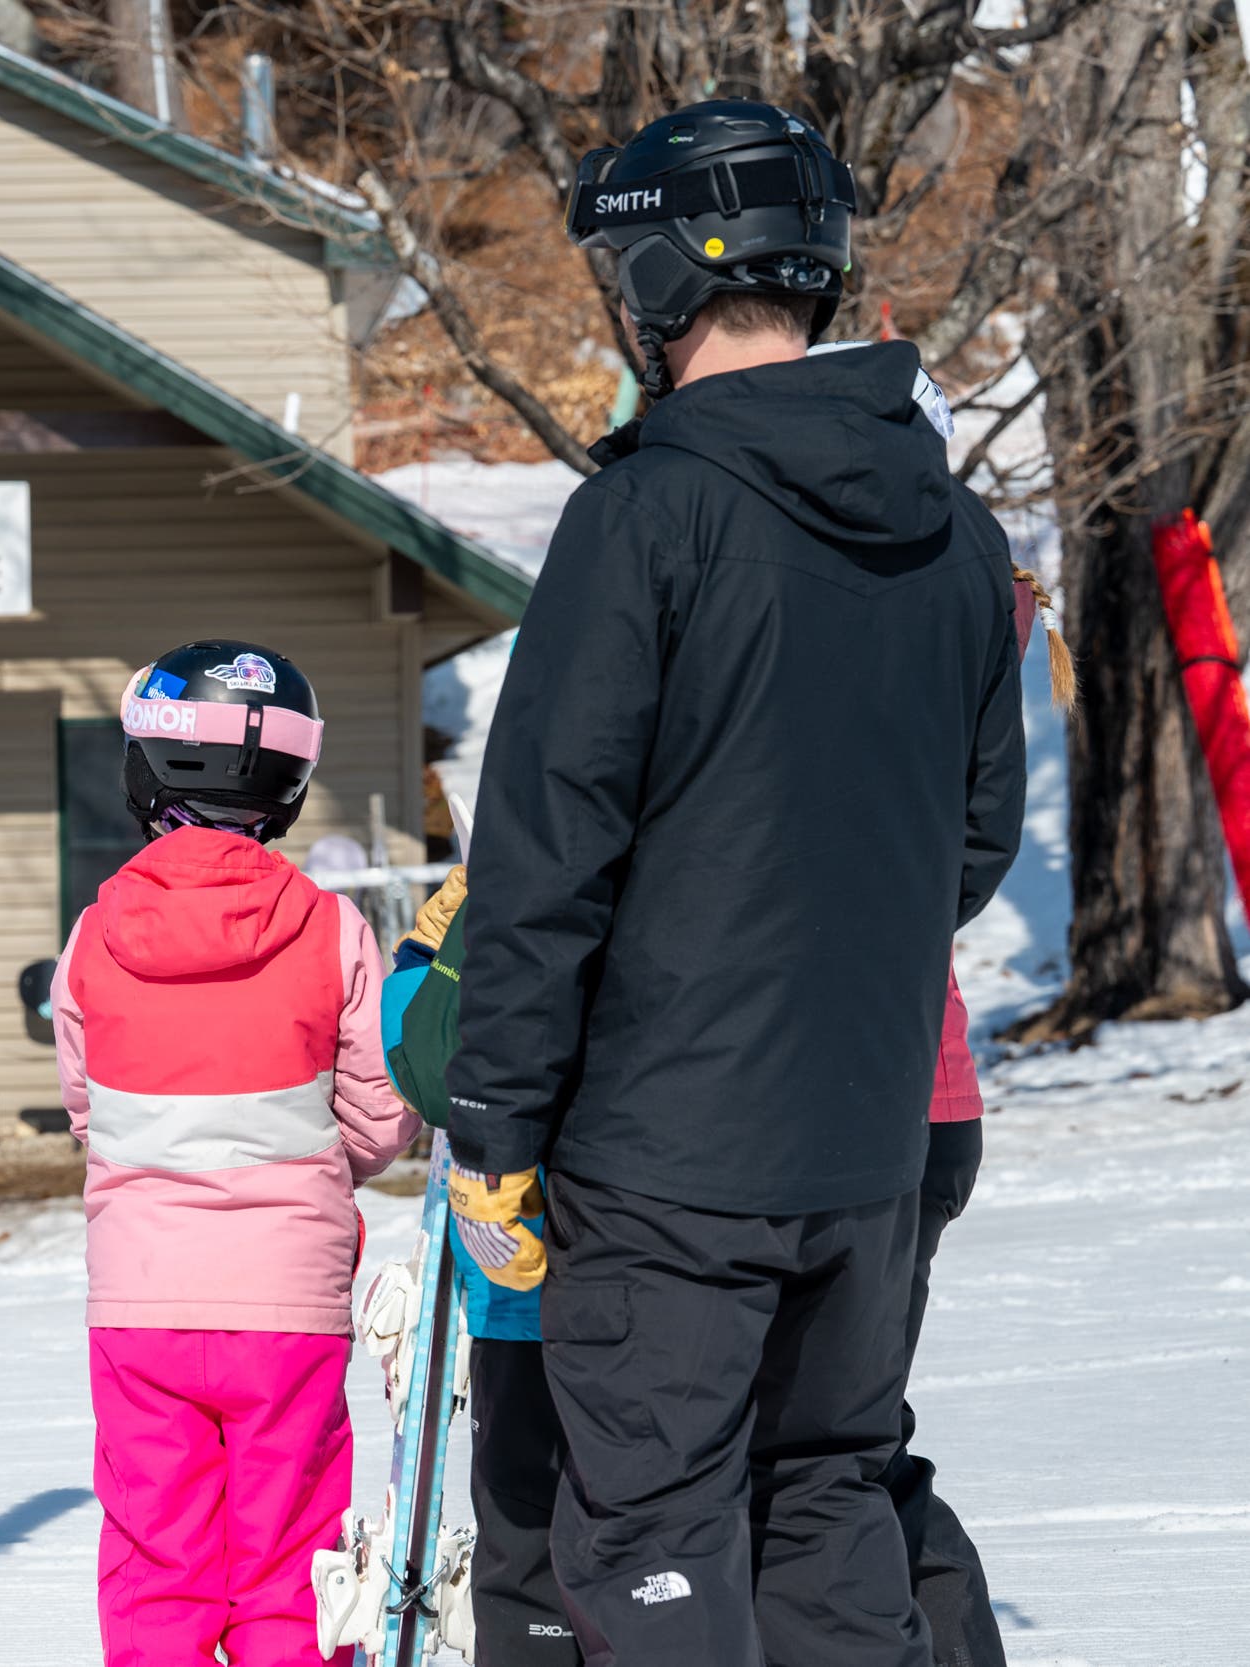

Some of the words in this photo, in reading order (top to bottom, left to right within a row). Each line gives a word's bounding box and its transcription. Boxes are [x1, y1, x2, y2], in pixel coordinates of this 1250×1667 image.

[595, 188, 662, 215] SMITH
[430, 958, 461, 982] olumbia
[450, 1097, 488, 1111] TECH
[644, 1573, 669, 1586] THE
[631, 1582, 671, 1601] NORTH
[643, 1590, 673, 1606] FACE
[528, 1623, 563, 1637] EXO
